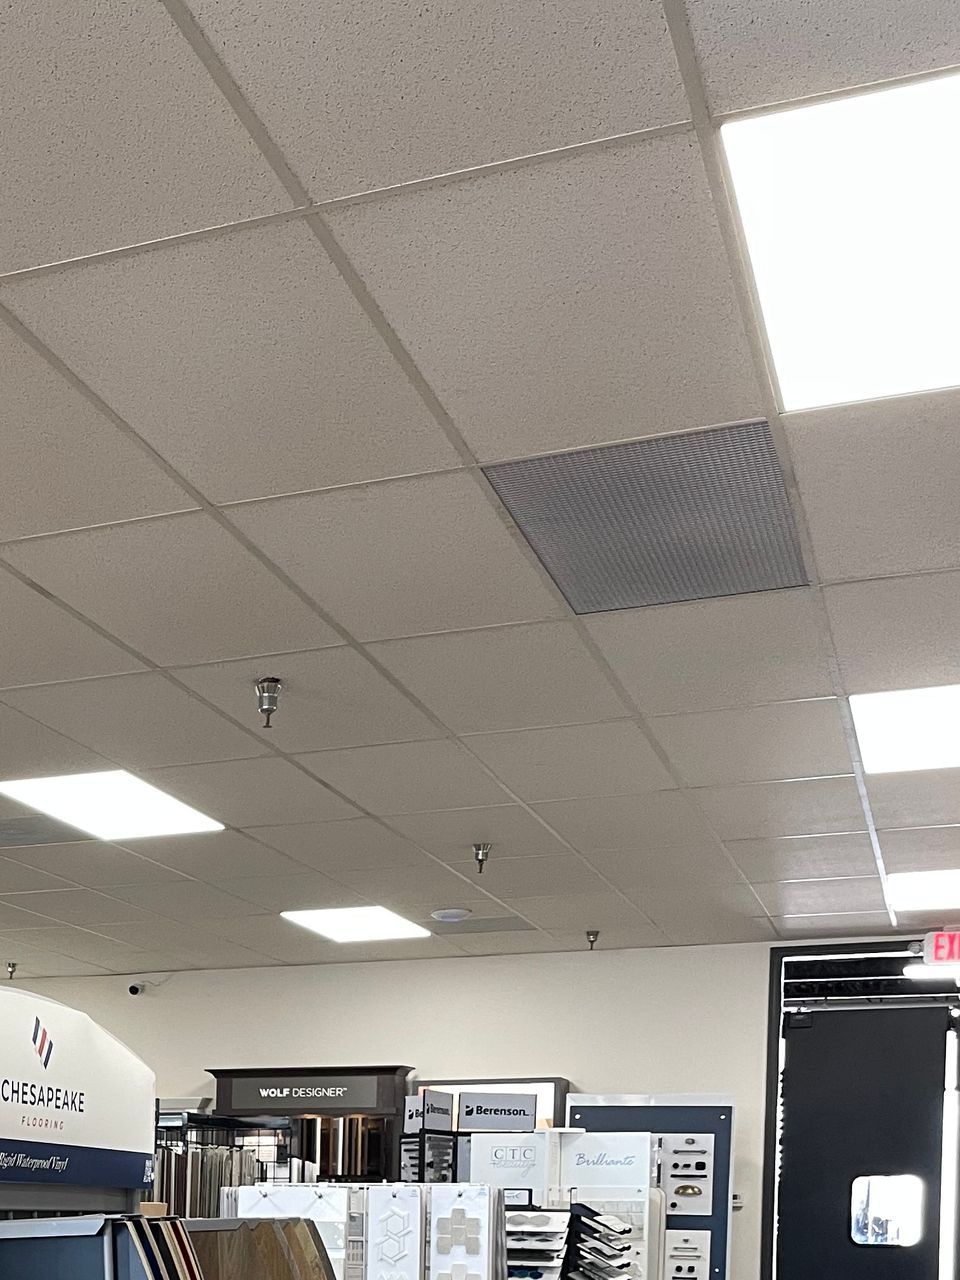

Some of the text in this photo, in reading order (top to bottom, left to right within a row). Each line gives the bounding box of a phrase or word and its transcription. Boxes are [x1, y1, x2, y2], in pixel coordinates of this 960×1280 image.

[1, 1079, 85, 1113] CHESAPEAKE
[259, 1088, 290, 1098] WOLF
[476, 1105, 527, 1116] Berenson
[21, 1116, 64, 1130] FLOORING
[493, 1148, 533, 1160] CTC
[16, 1153, 53, 1172] Waterproof
[51, 1156, 69, 1173] Vinyl
